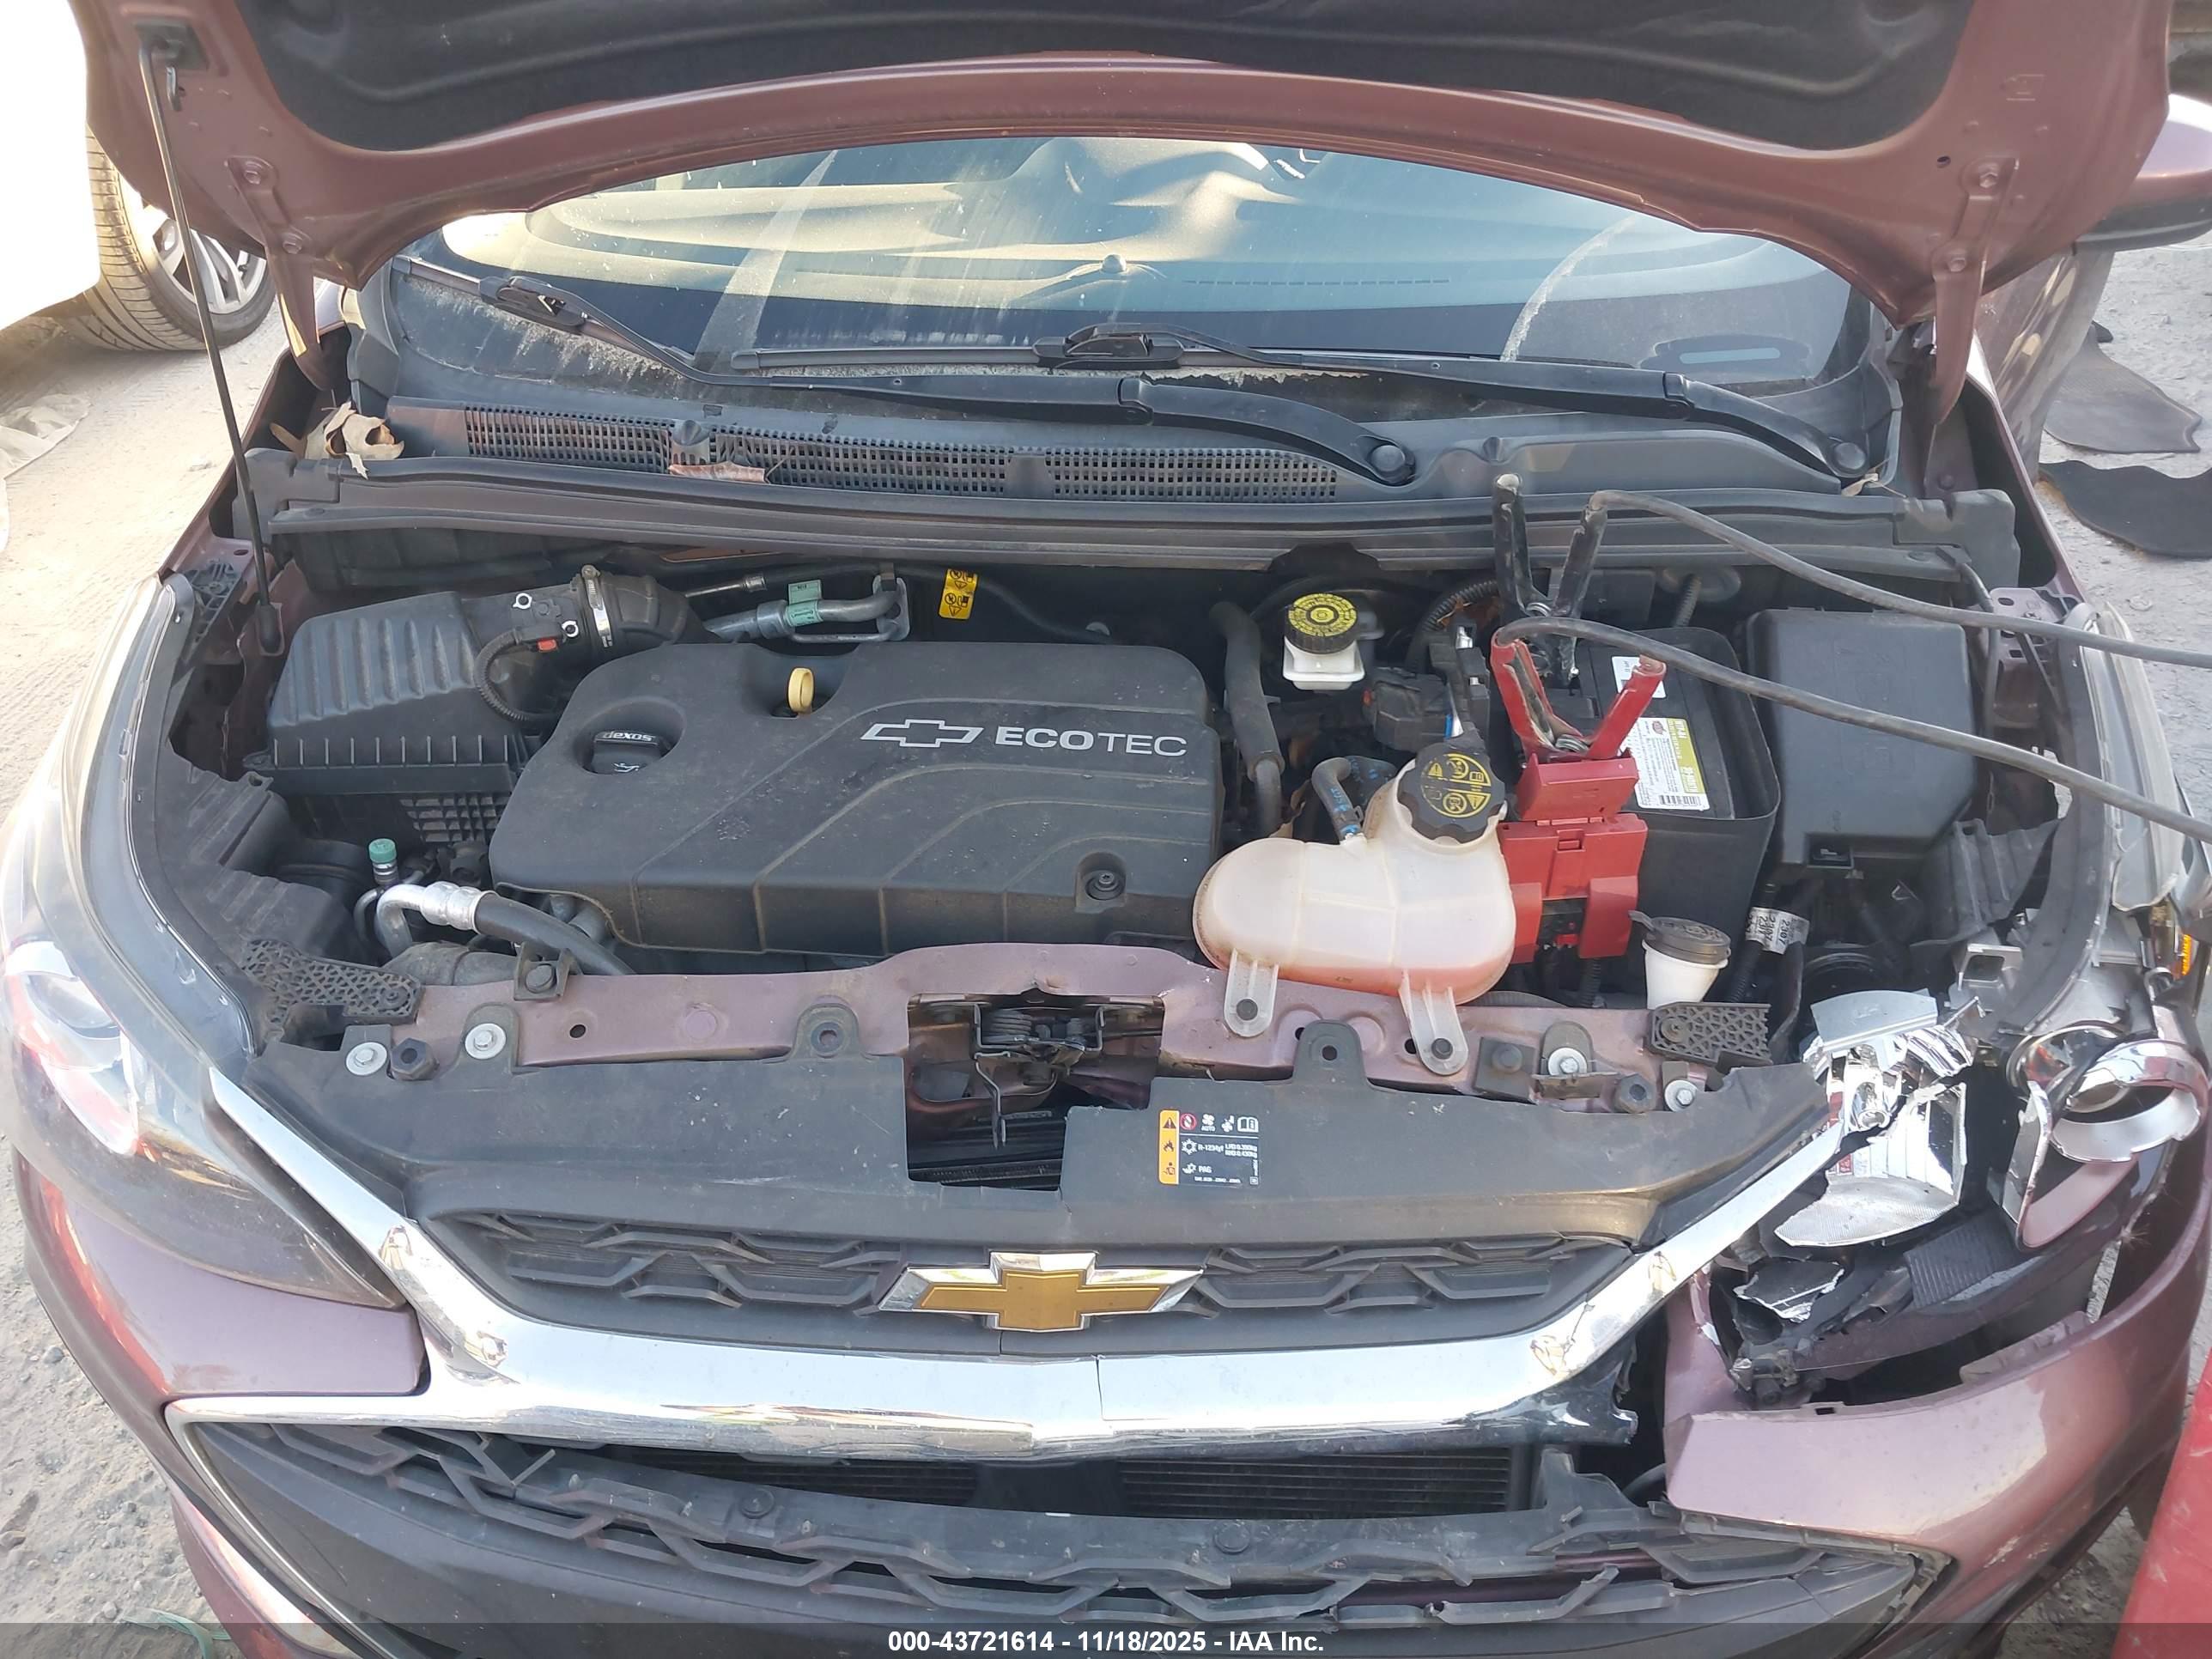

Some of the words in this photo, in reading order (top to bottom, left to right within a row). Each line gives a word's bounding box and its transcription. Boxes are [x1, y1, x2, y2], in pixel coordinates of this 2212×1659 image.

[603, 731, 656, 741] dexos
[995, 726, 1188, 757] ECOTEC
[1778, 920, 1790, 945] 2307
[1198, 1165, 1212, 1174] PAG
